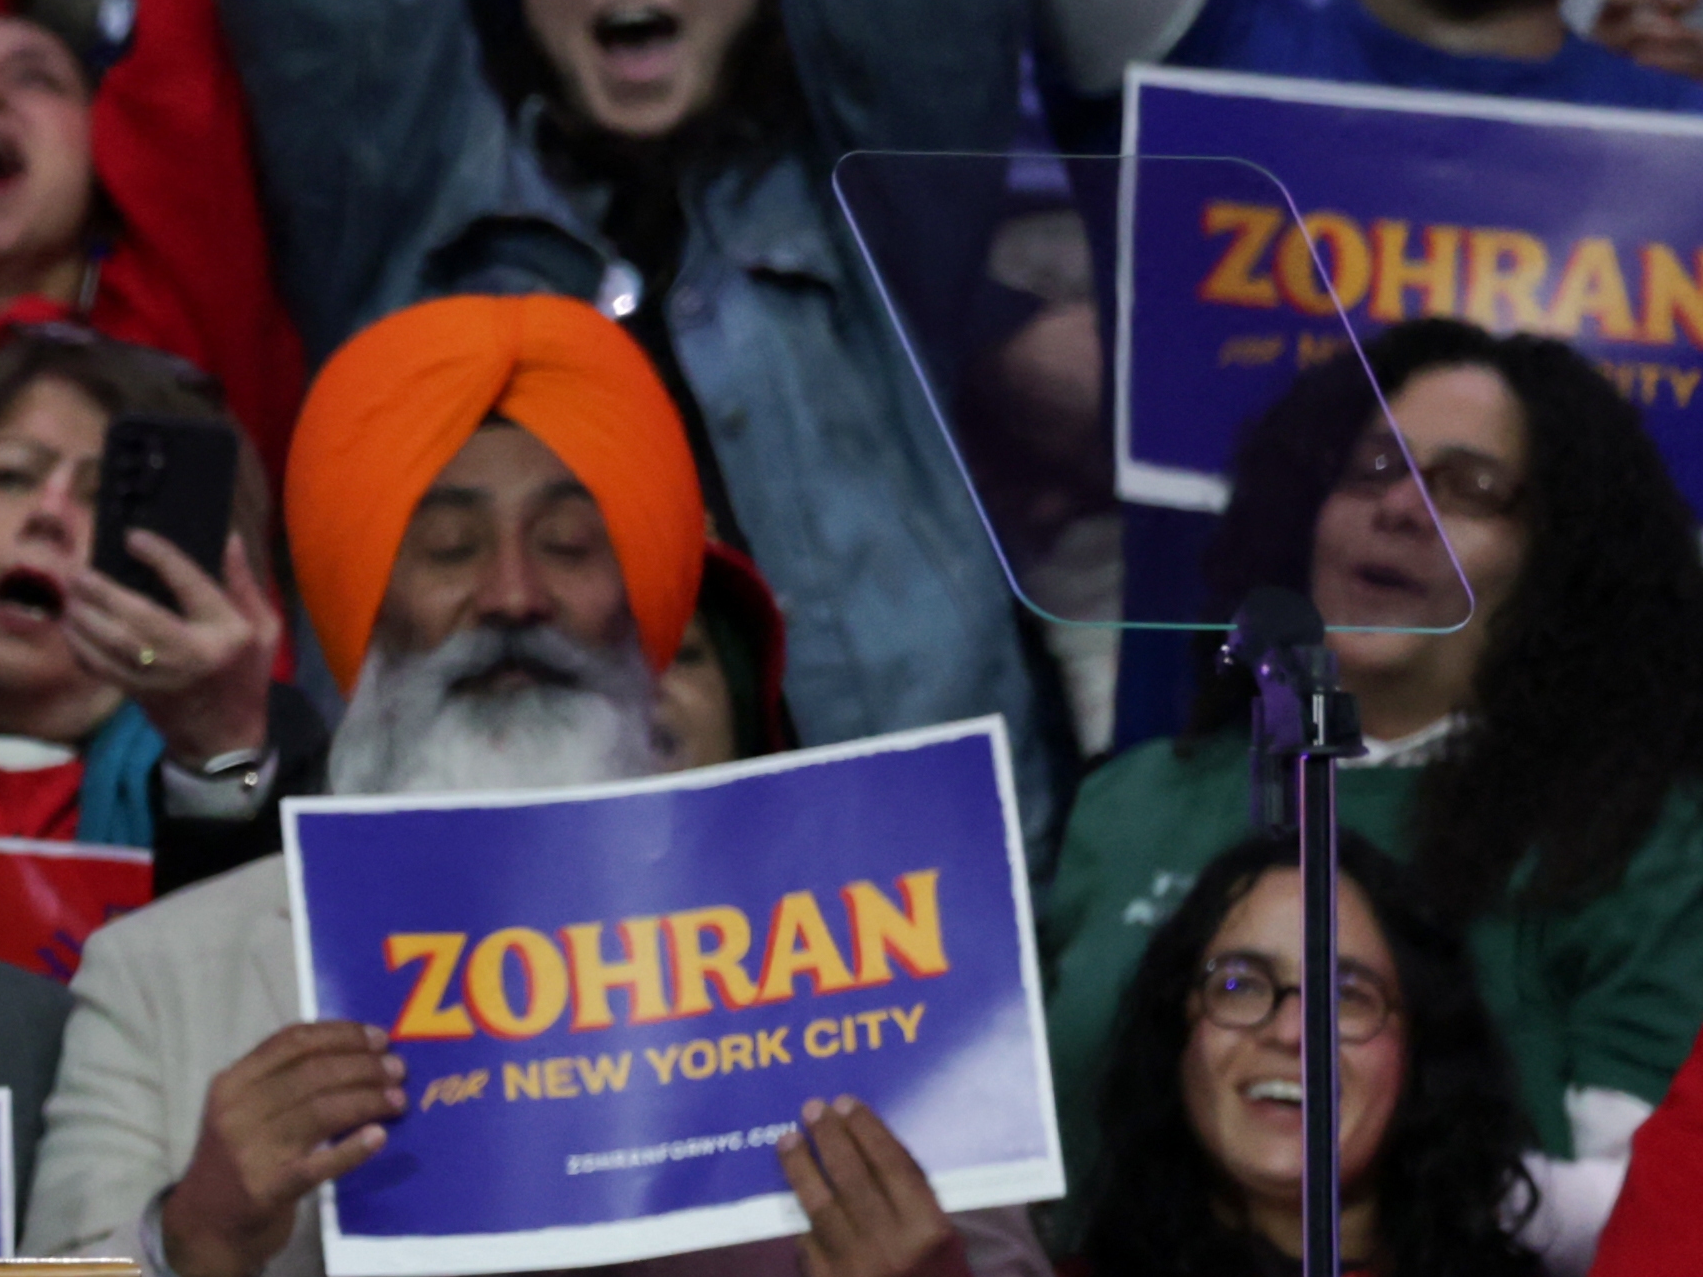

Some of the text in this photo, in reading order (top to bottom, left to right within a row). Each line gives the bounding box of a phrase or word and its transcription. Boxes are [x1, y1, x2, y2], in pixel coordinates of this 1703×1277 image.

[1199, 197, 1703, 352] ZOHRAN
[382, 868, 950, 1043] ZOHRAN
[502, 1052, 634, 1103] NEW
[644, 1026, 794, 1082] YORK
[802, 1004, 929, 1059] CITY
